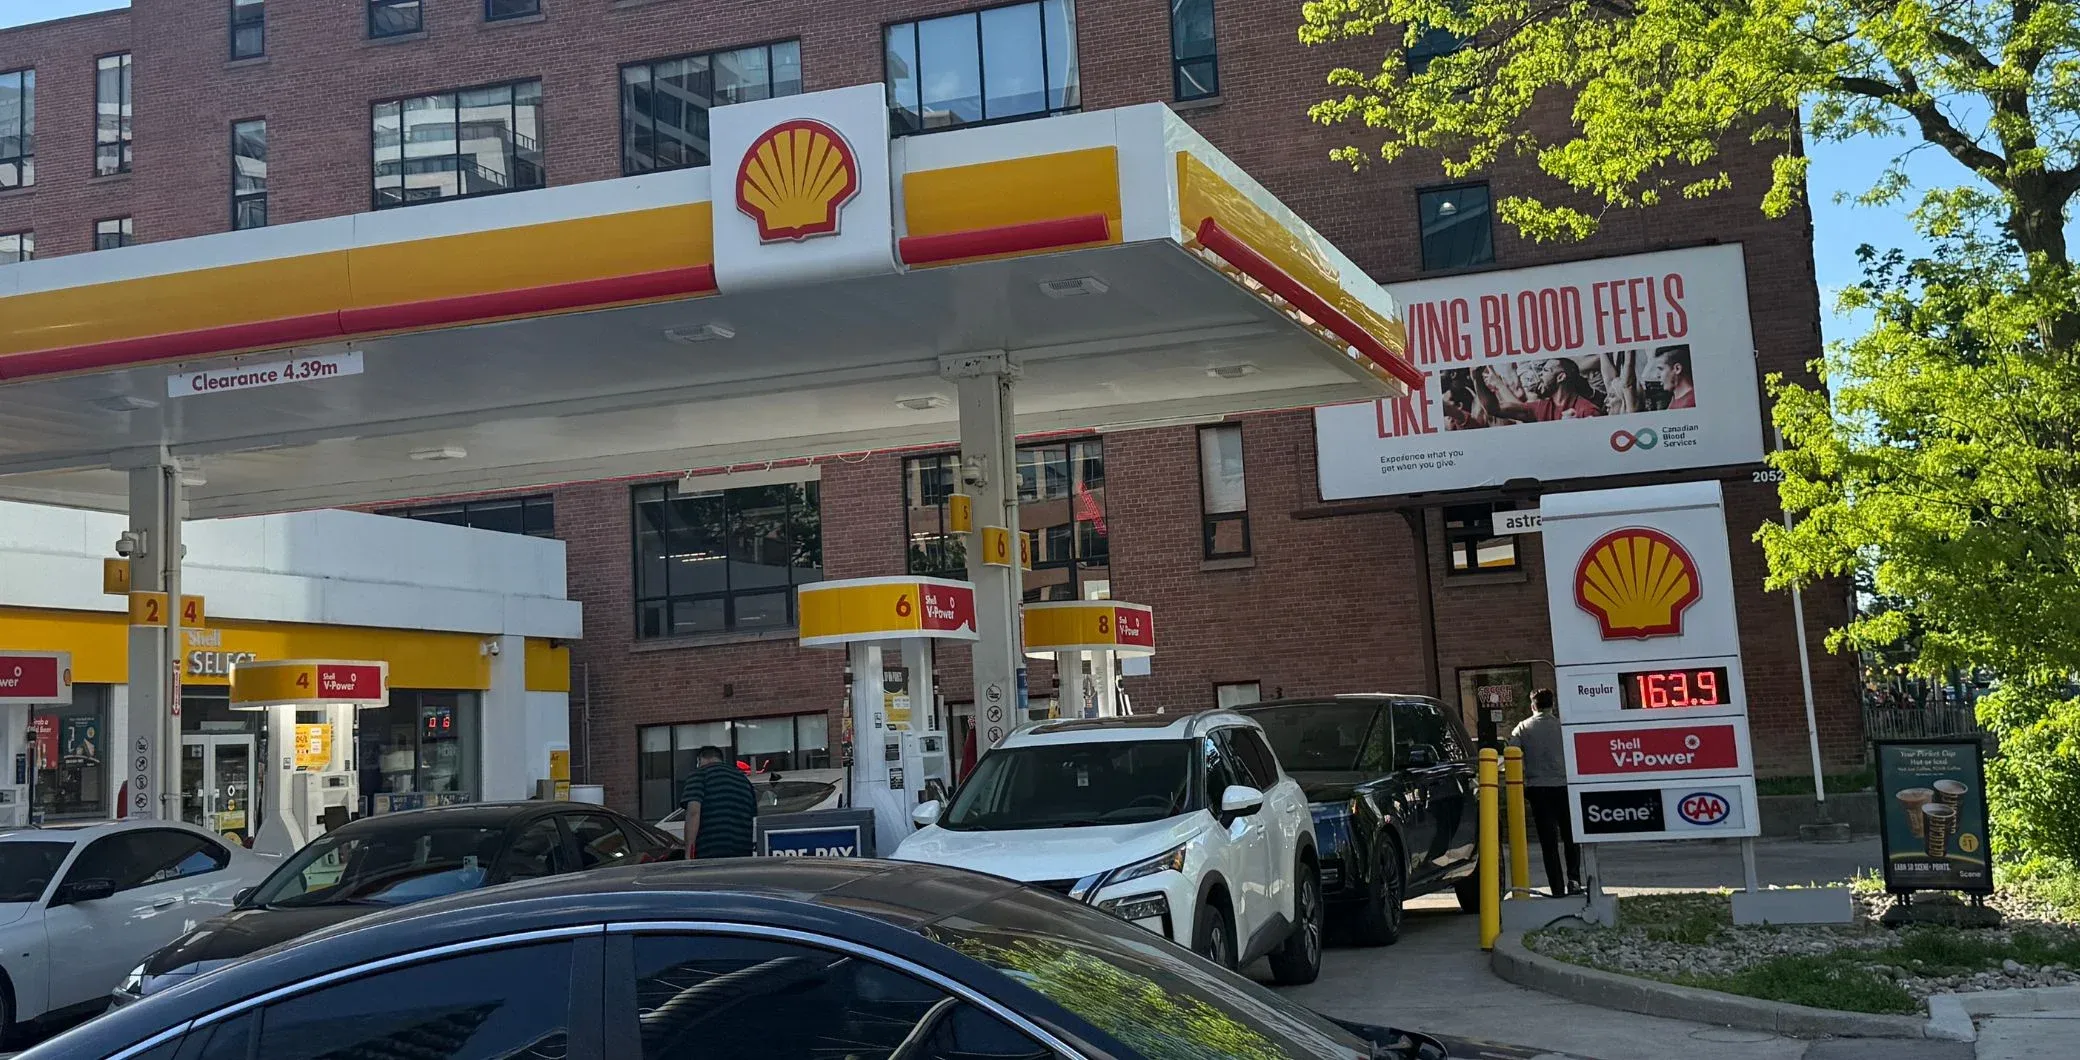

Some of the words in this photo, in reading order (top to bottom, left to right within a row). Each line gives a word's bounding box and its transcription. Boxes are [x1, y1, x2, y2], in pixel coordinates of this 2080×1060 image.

[1479, 286, 1585, 358] BLOOD
[1592, 273, 1689, 346] FEELS
[192, 369, 278, 391] Clearance
[283, 360, 338, 380] 4.39m
[1375, 371, 1438, 439] LIKE
[1662, 423, 1699, 433] Canadian
[1663, 432, 1686, 440] Blood
[1663, 439, 1697, 448] Services
[1380, 453, 1425, 464] Experience
[1427, 450, 1447, 459] what
[1448, 449, 1464, 459] you
[1381, 464, 1395, 474] get
[1397, 462, 1418, 471] when
[1419, 461, 1435, 470] you
[1436, 459, 1456, 469] give.
[1752, 469, 1785, 483] 2052
[963, 505, 968, 520] 5
[997, 533, 1005, 558] 6
[1020, 538, 1027, 564] 8
[117, 569, 123, 582] 1
[895, 594, 912, 618] 6
[925, 595, 937, 606] Shell
[146, 598, 159, 623] 2
[184, 600, 197, 623] 4
[926, 605, 955, 620] V-Power
[1098, 615, 1109, 634] 8
[188, 630, 222, 647] Shell
[295, 672, 310, 689] 4
[322, 672, 336, 681] Shell
[323, 681, 356, 691] V-Power
[1577, 684, 1614, 697] Regular
[1636, 671, 1718, 709] 163.9
[1609, 738, 1641, 751] Shell
[1611, 751, 1695, 767] V-Power
[1683, 796, 1723, 820] CAA
